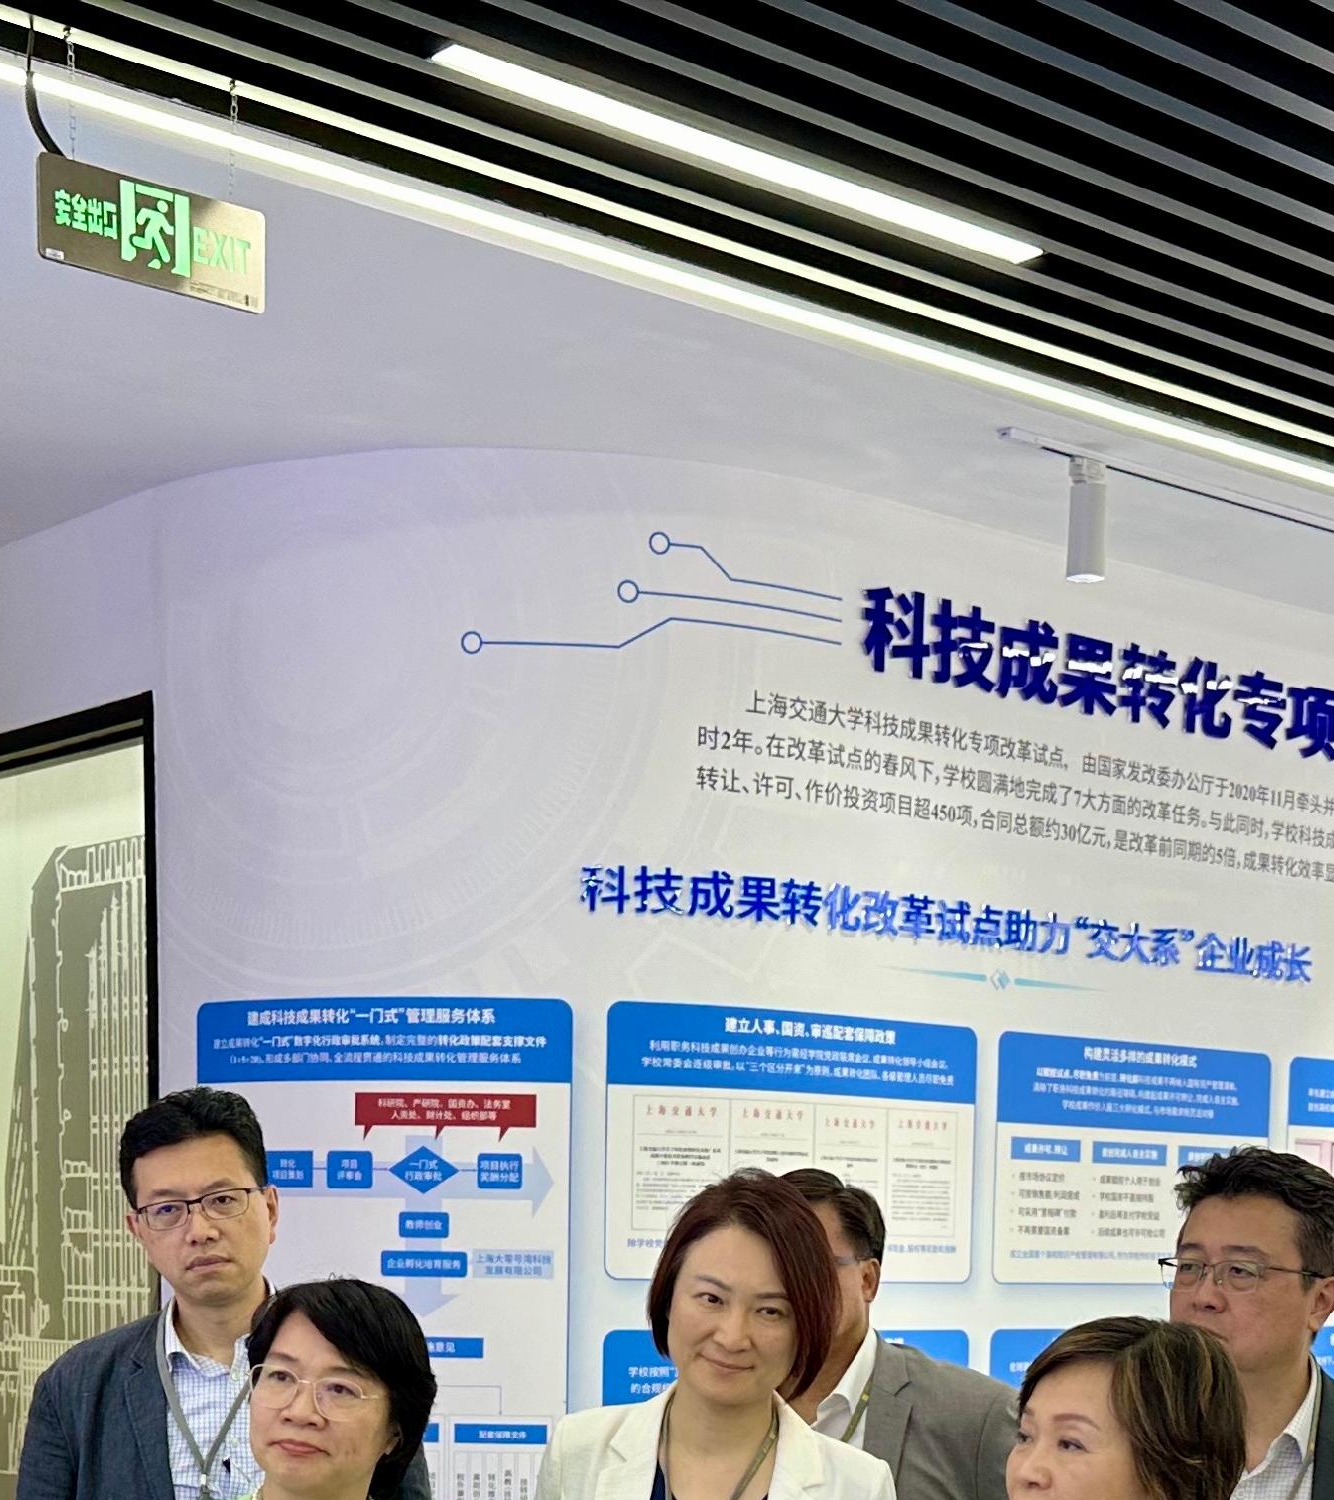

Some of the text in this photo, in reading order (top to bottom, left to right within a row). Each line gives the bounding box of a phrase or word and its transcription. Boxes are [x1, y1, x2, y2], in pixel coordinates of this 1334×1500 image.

[54, 188, 117, 240] 安全出口
[193, 226, 251, 276] EXIT
[580, 865, 1313, 984] 科技成果转化改革试点助力“交大系”企业成长
[247, 1007, 496, 1026] 建成科技成果转化“一门式”管理服务体系
[646, 1104, 718, 1118] 上海交通大学
[742, 1107, 804, 1121] 上海交通大学
[825, 1117, 875, 1130] 上海交通大学
[341, 1159, 358, 1169] 项目
[409, 1159, 438, 1170] 一门式
[480, 1160, 519, 1171] 项目执行
[404, 1171, 442, 1182] 行政审批
[405, 1219, 443, 1230] 教师创业
[386, 1257, 461, 1270] 企业孵化培育服务
[475, 1254, 552, 1265] 上海大零号湾科技
[485, 1266, 543, 1276] 发展有限公司
[628, 1366, 679, 1377] 学校按照“
